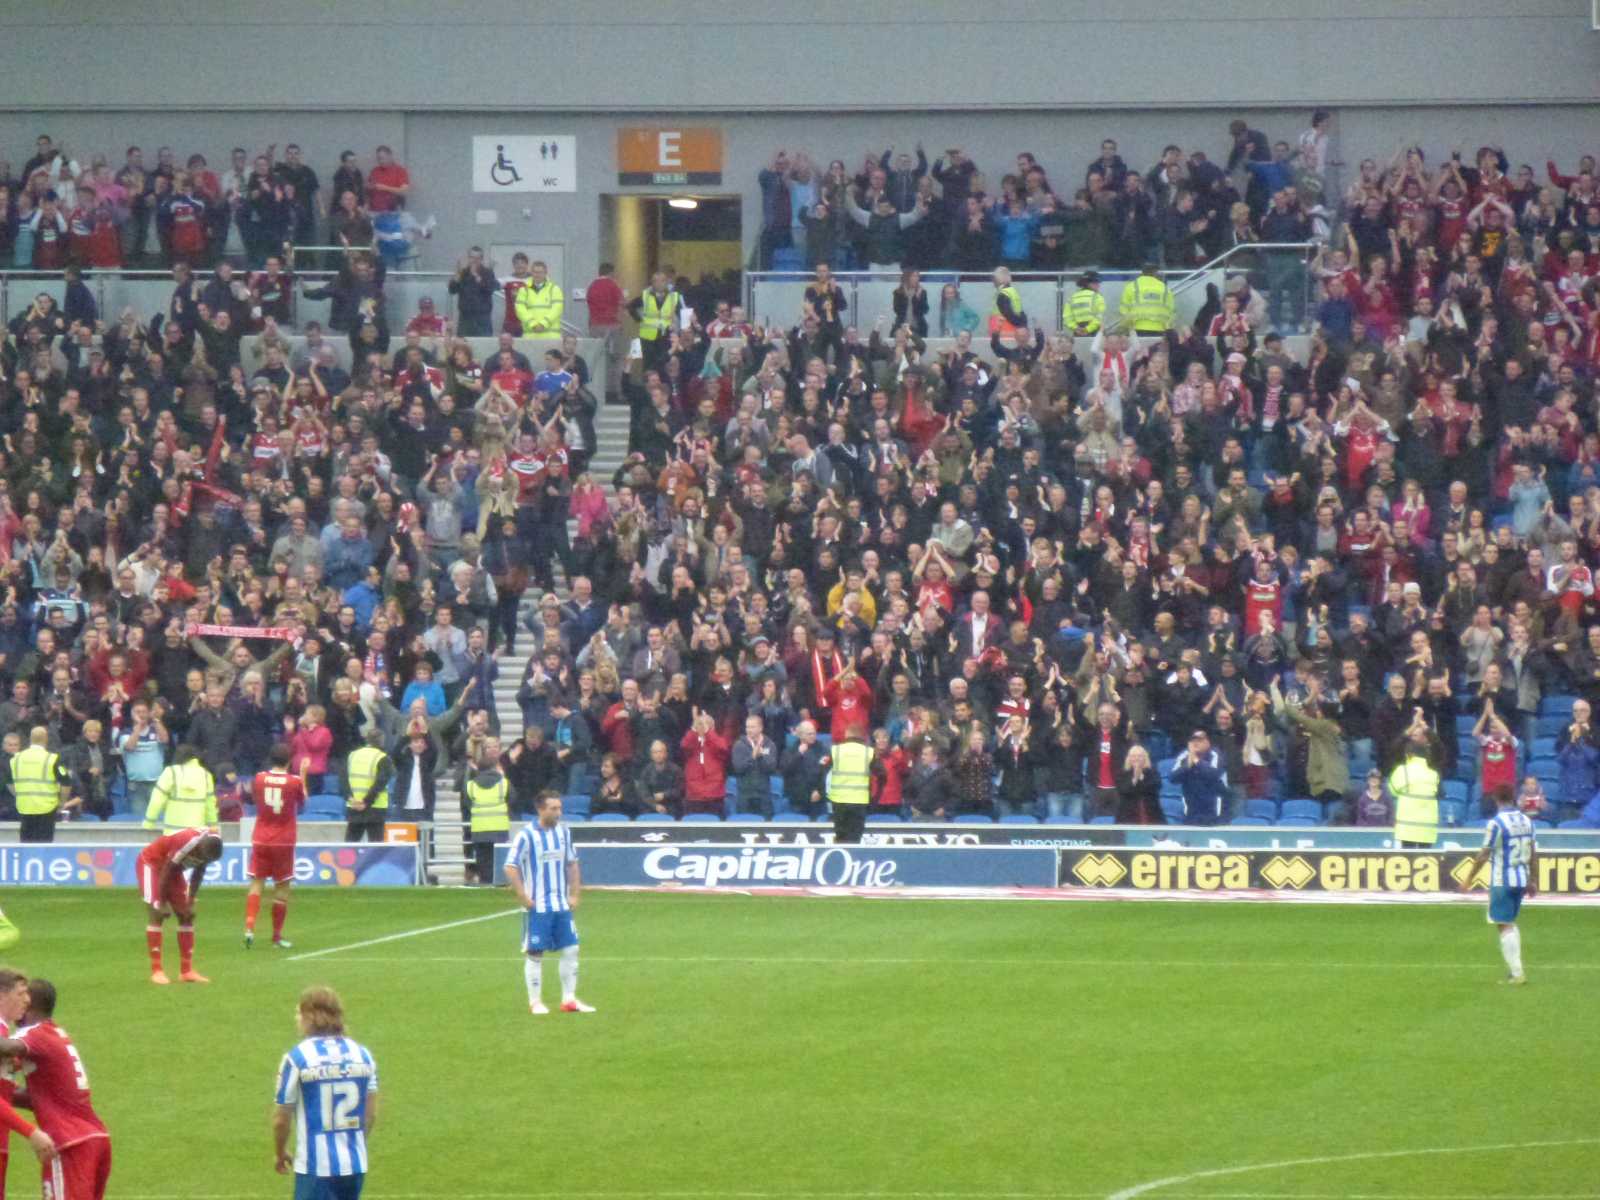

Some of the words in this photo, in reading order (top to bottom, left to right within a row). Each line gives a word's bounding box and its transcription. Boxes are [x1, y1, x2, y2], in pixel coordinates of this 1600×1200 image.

[659, 132, 681, 166] E
[543, 177, 559, 187] WC
[264, 786, 284, 815] 4
[320, 1080, 360, 1132] 12
